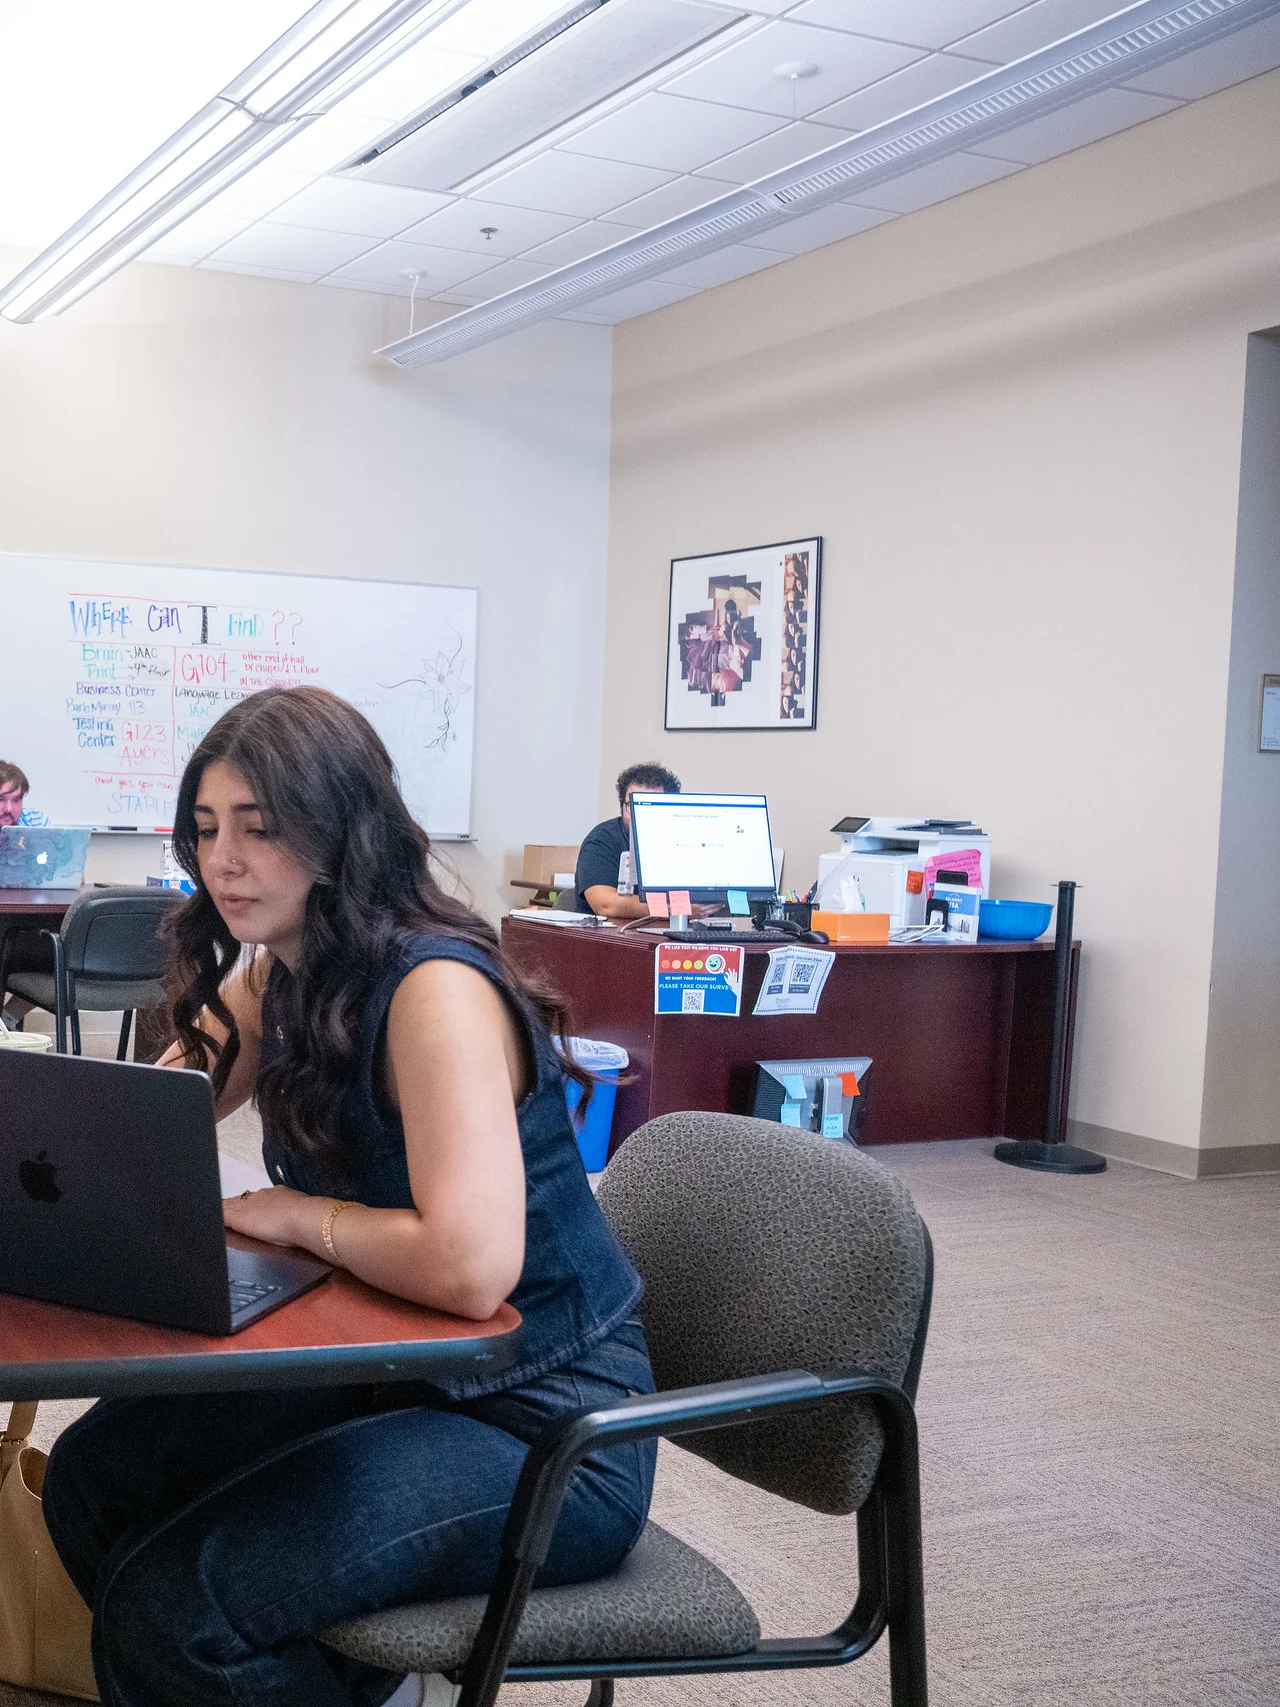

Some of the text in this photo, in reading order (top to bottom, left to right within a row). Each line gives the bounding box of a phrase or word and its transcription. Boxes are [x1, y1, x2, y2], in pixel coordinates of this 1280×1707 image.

[187, 604, 221, 646] I
[84, 664, 116, 680] Print
[181, 652, 228, 684] G104
[76, 683, 122, 696] Business
[175, 686, 221, 705] Language
[78, 732, 117, 748] Center
